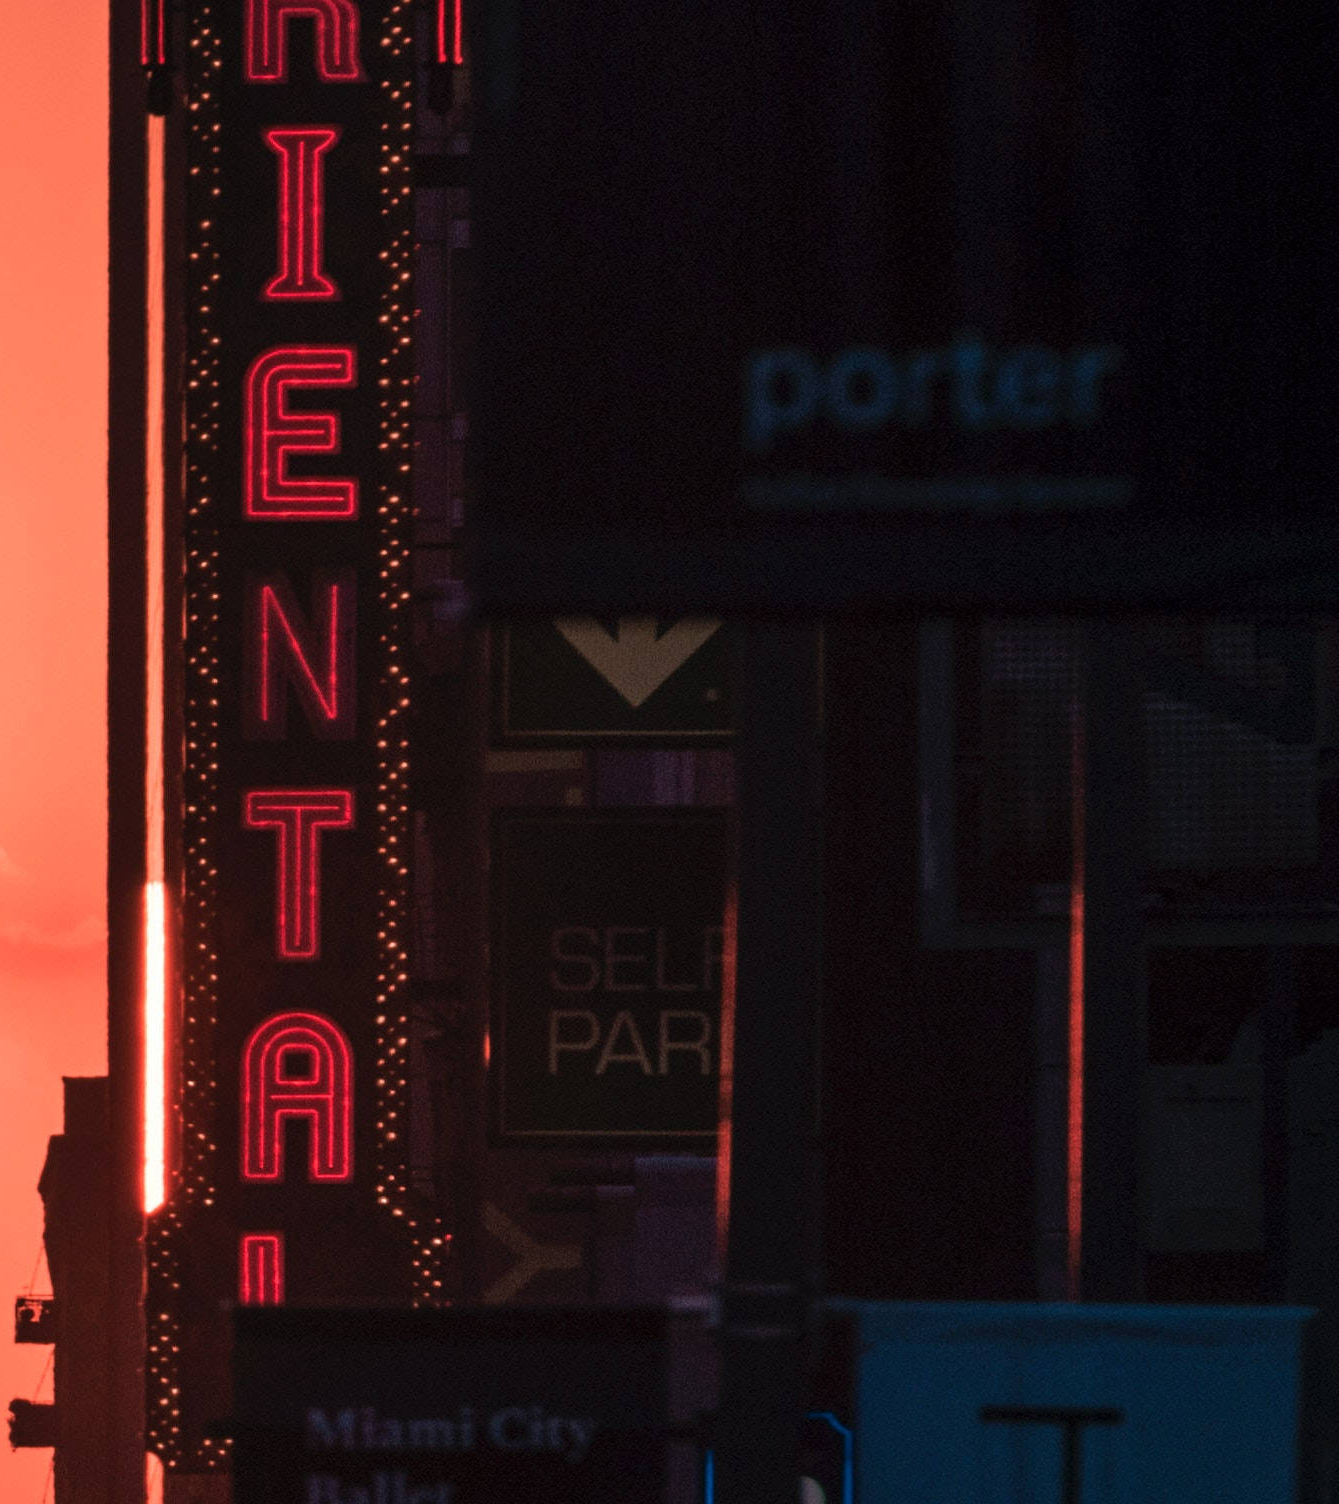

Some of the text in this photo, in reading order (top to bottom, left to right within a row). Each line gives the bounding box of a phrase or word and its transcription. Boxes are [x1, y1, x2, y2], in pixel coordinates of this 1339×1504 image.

[745, 328, 1121, 452] porter
[548, 1011, 715, 1076] PAR
[306, 1405, 600, 1464] Miami City
